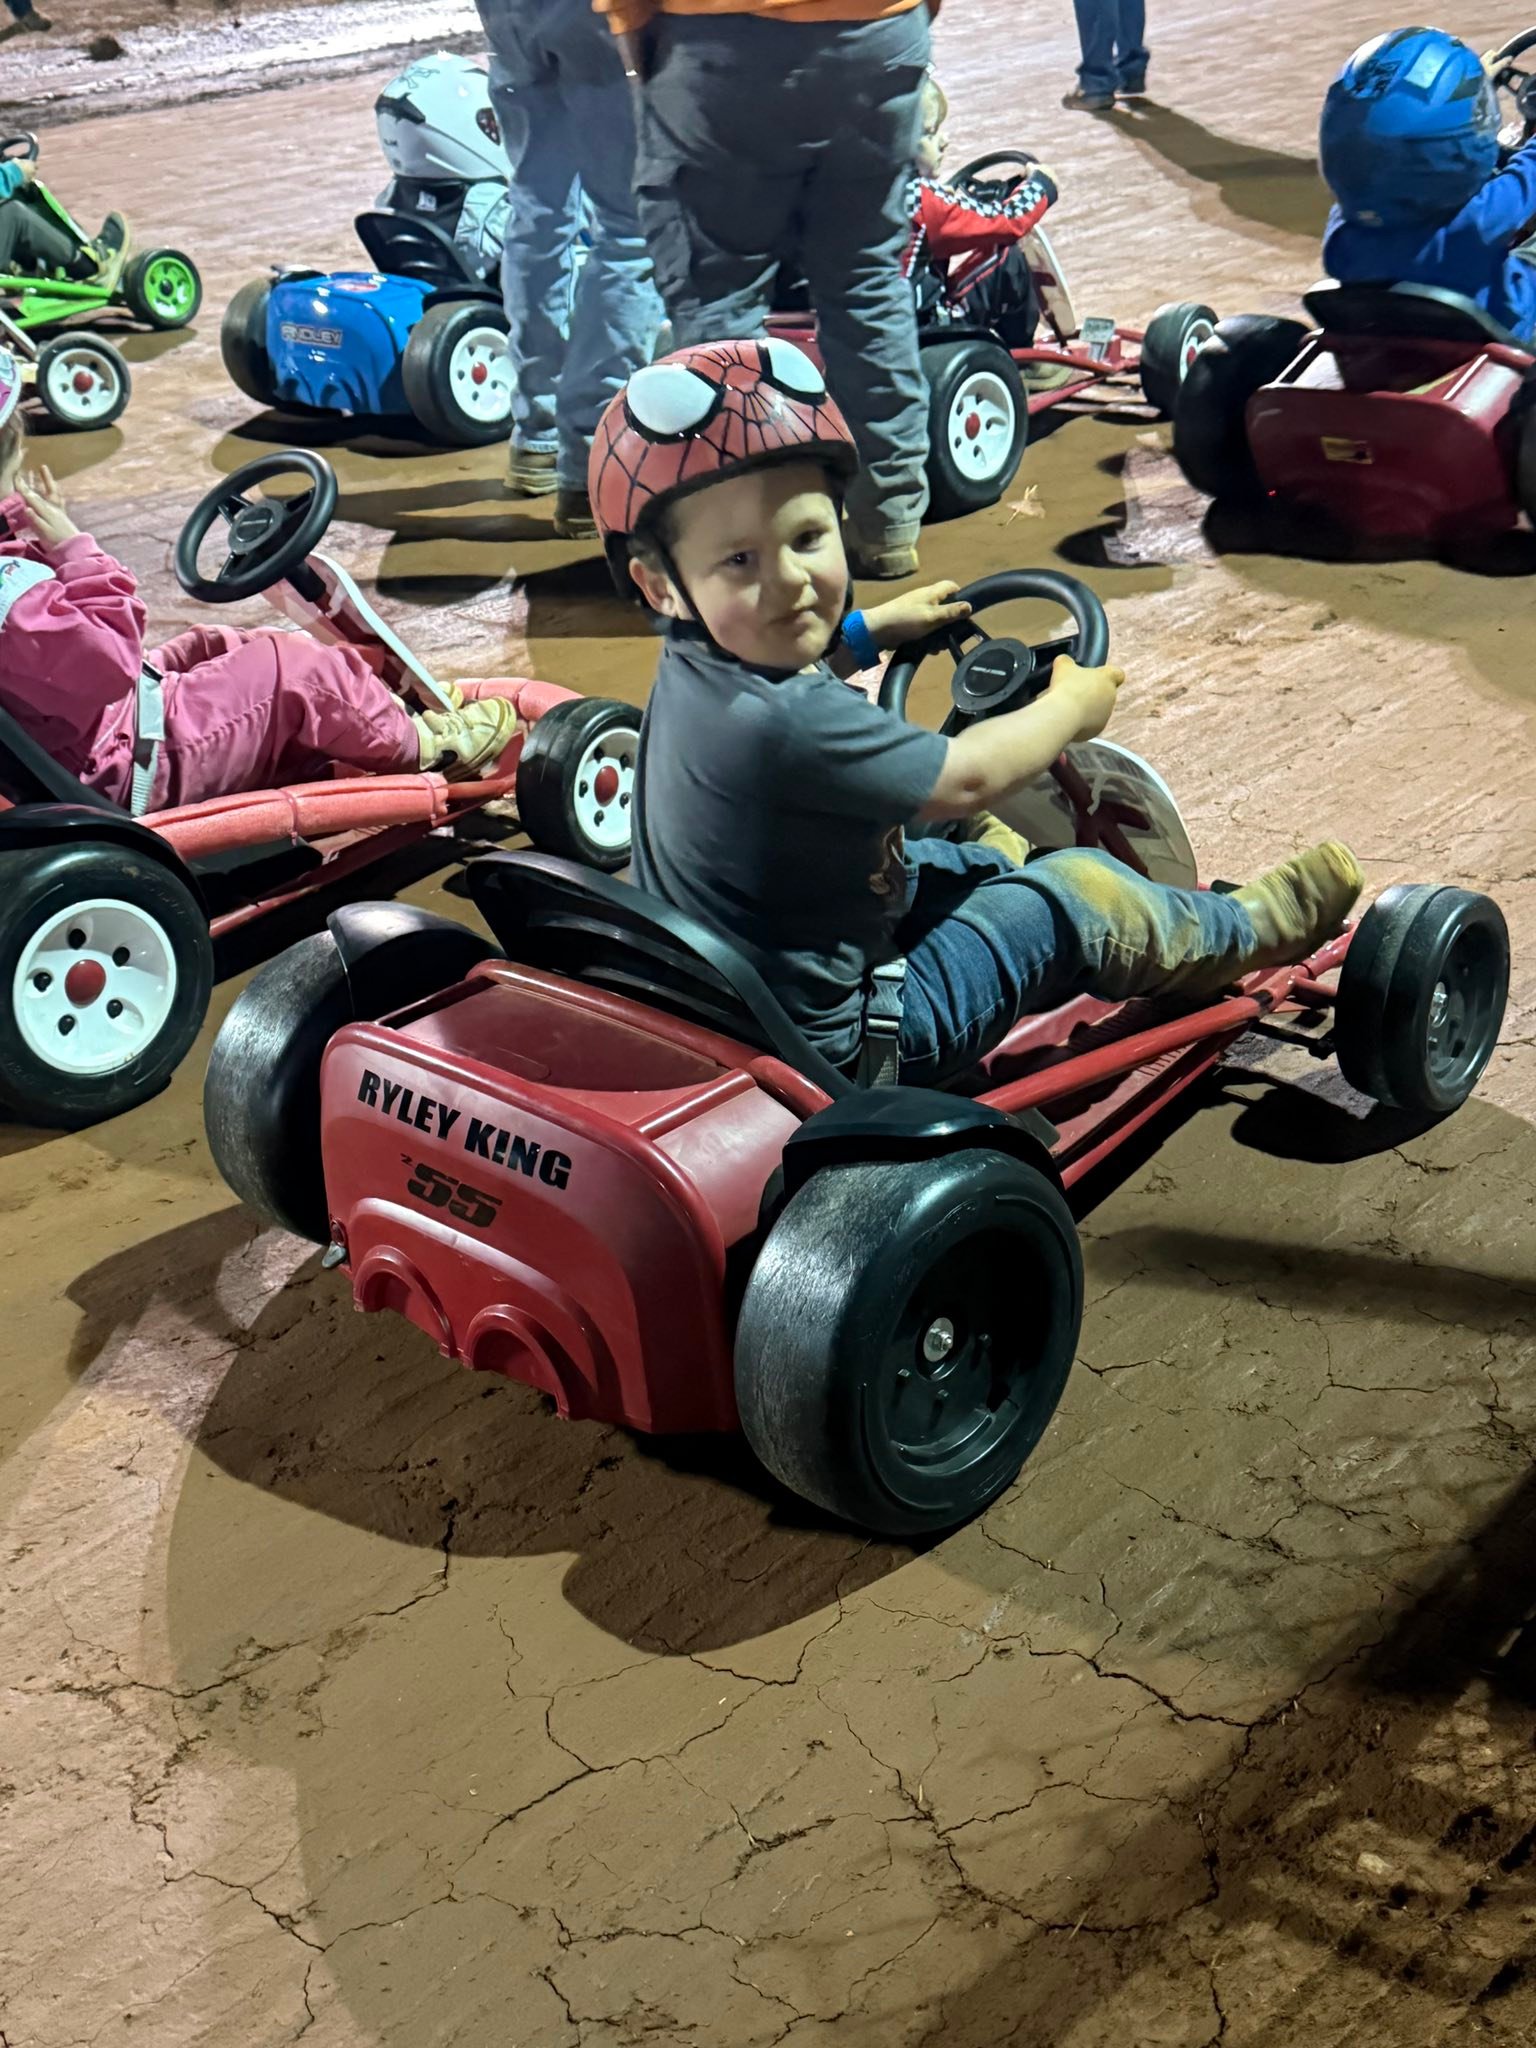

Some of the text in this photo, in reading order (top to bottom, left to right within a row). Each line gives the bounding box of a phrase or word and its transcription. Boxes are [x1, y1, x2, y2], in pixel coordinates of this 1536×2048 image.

[357, 1069, 572, 1190] RYLEY KING
[407, 1163, 503, 1228] 55
